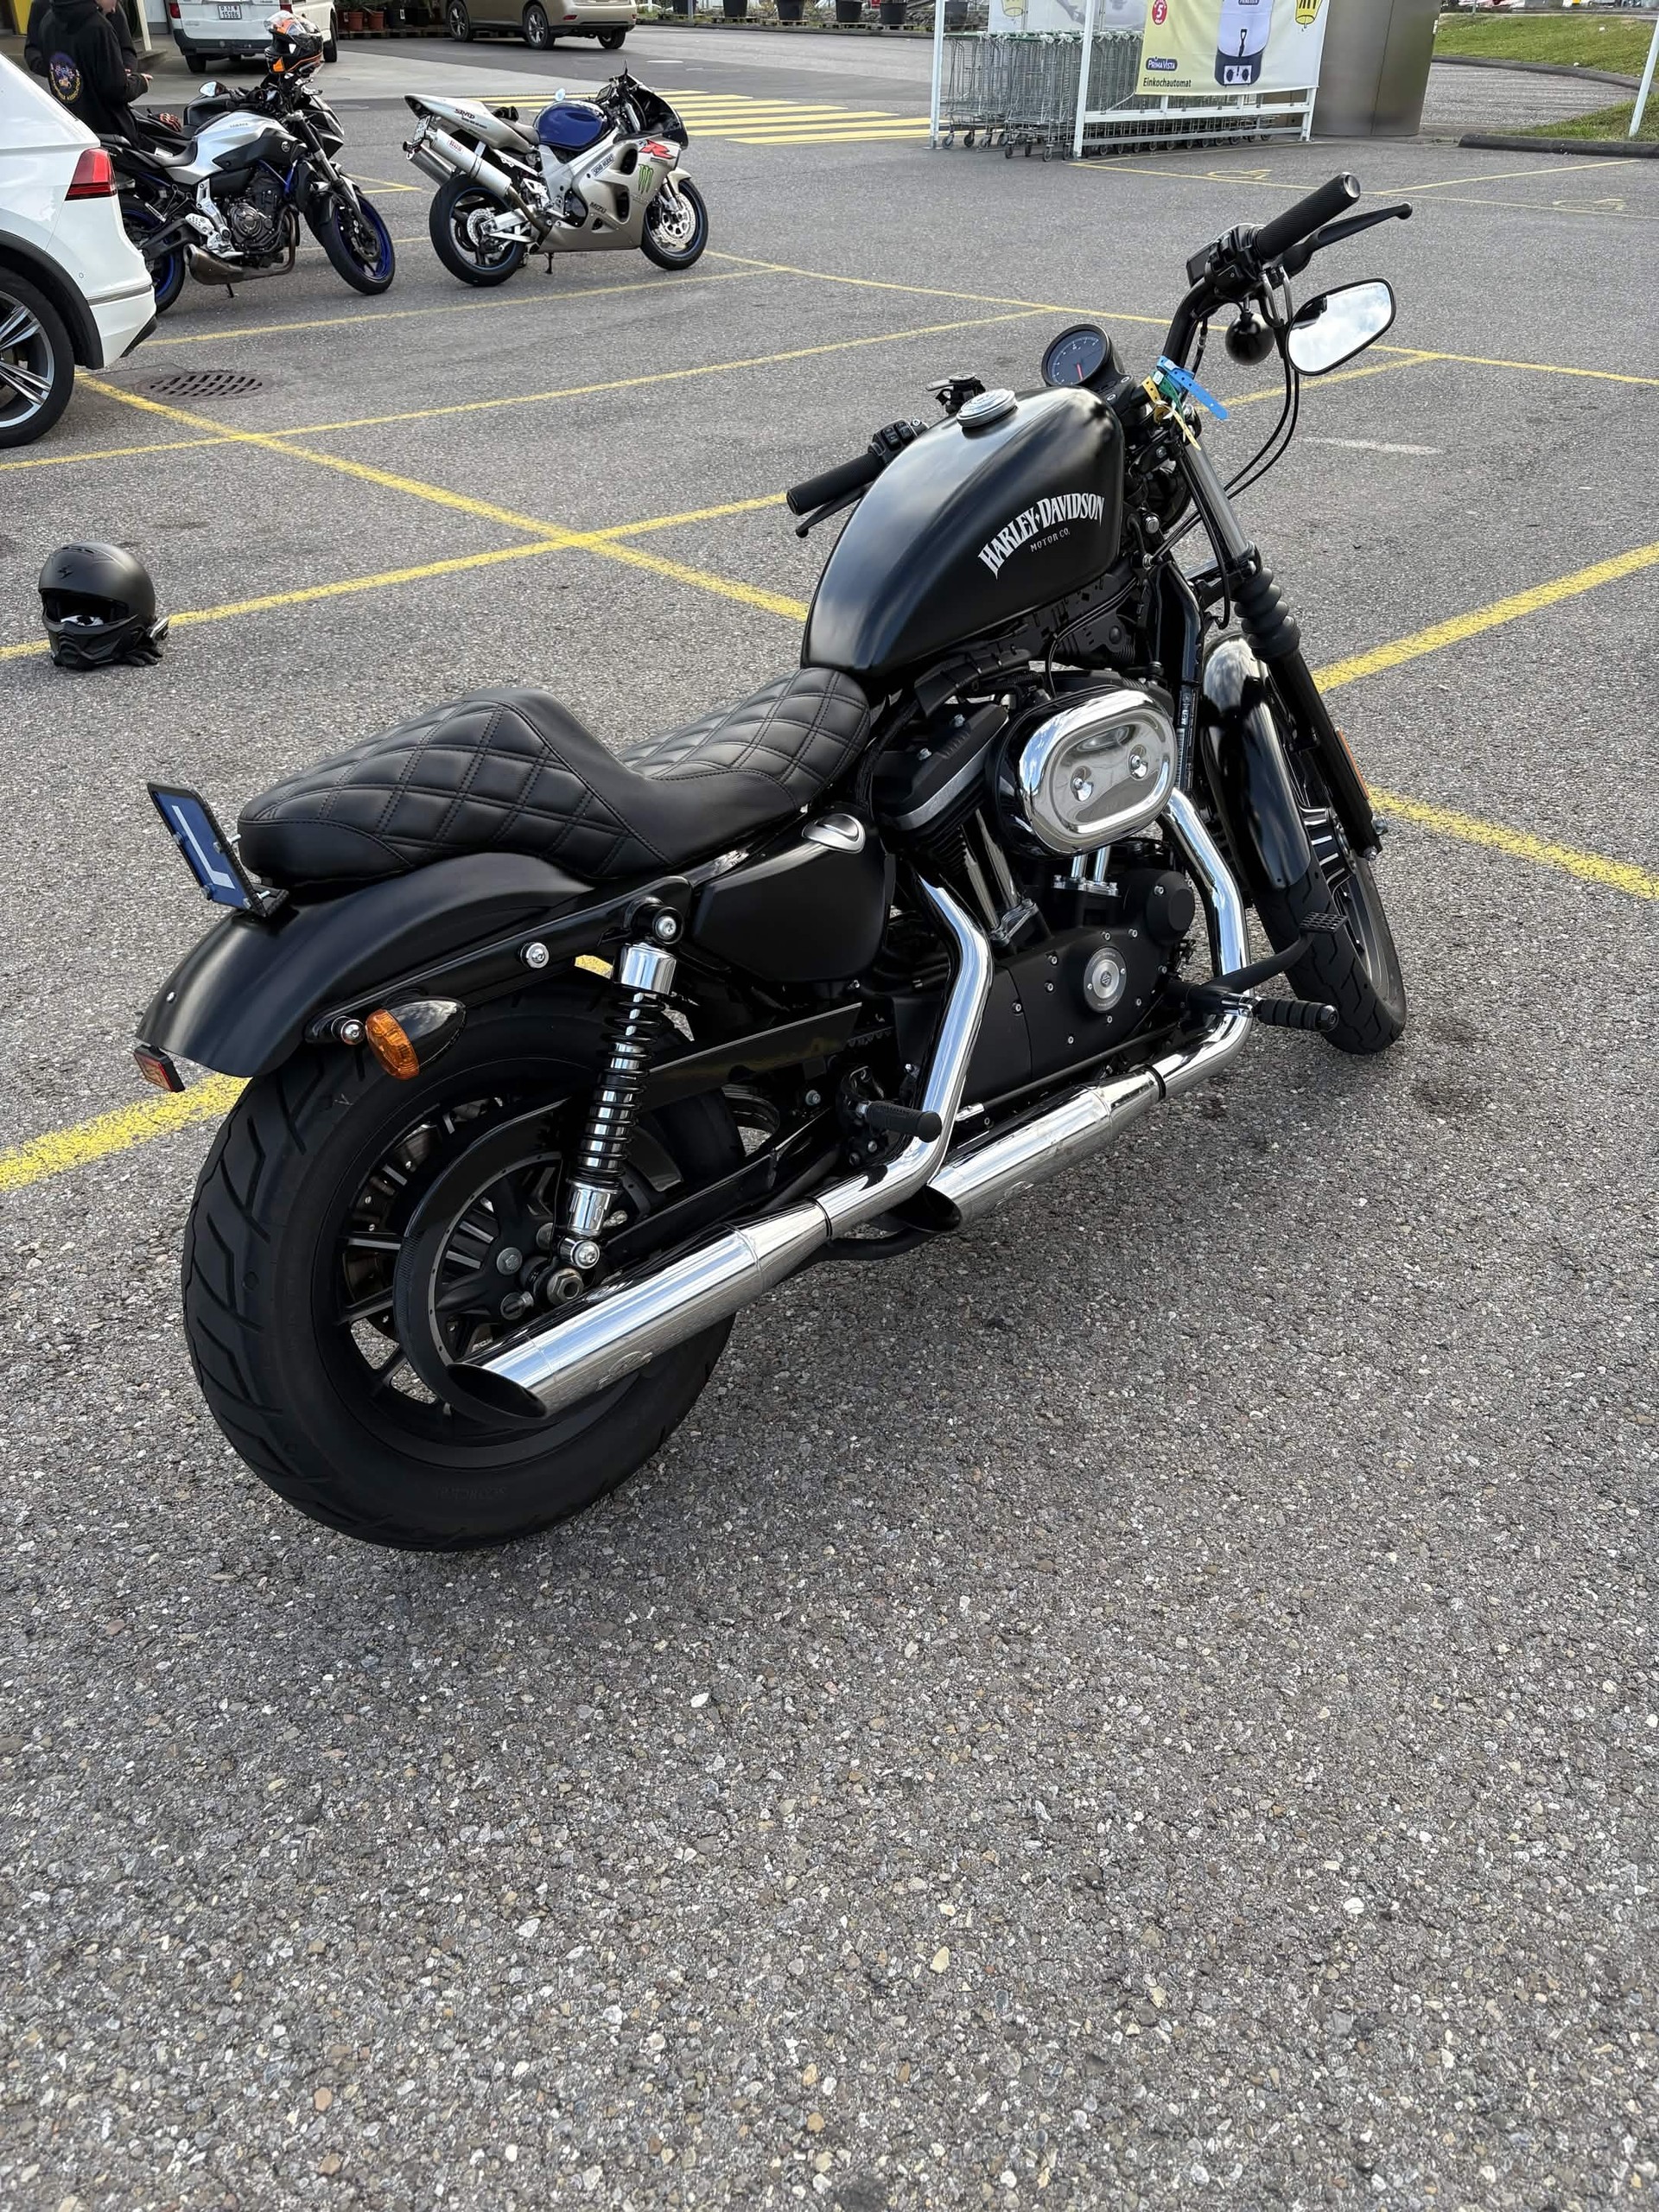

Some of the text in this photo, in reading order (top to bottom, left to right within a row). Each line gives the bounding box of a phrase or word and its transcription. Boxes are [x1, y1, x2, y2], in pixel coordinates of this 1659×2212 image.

[1155, 3, 1164, 18] 5
[1143, 77, 1192, 87] Einkochautomat
[1029, 532, 1058, 553] MOTOR
[171, 804, 236, 890] L
